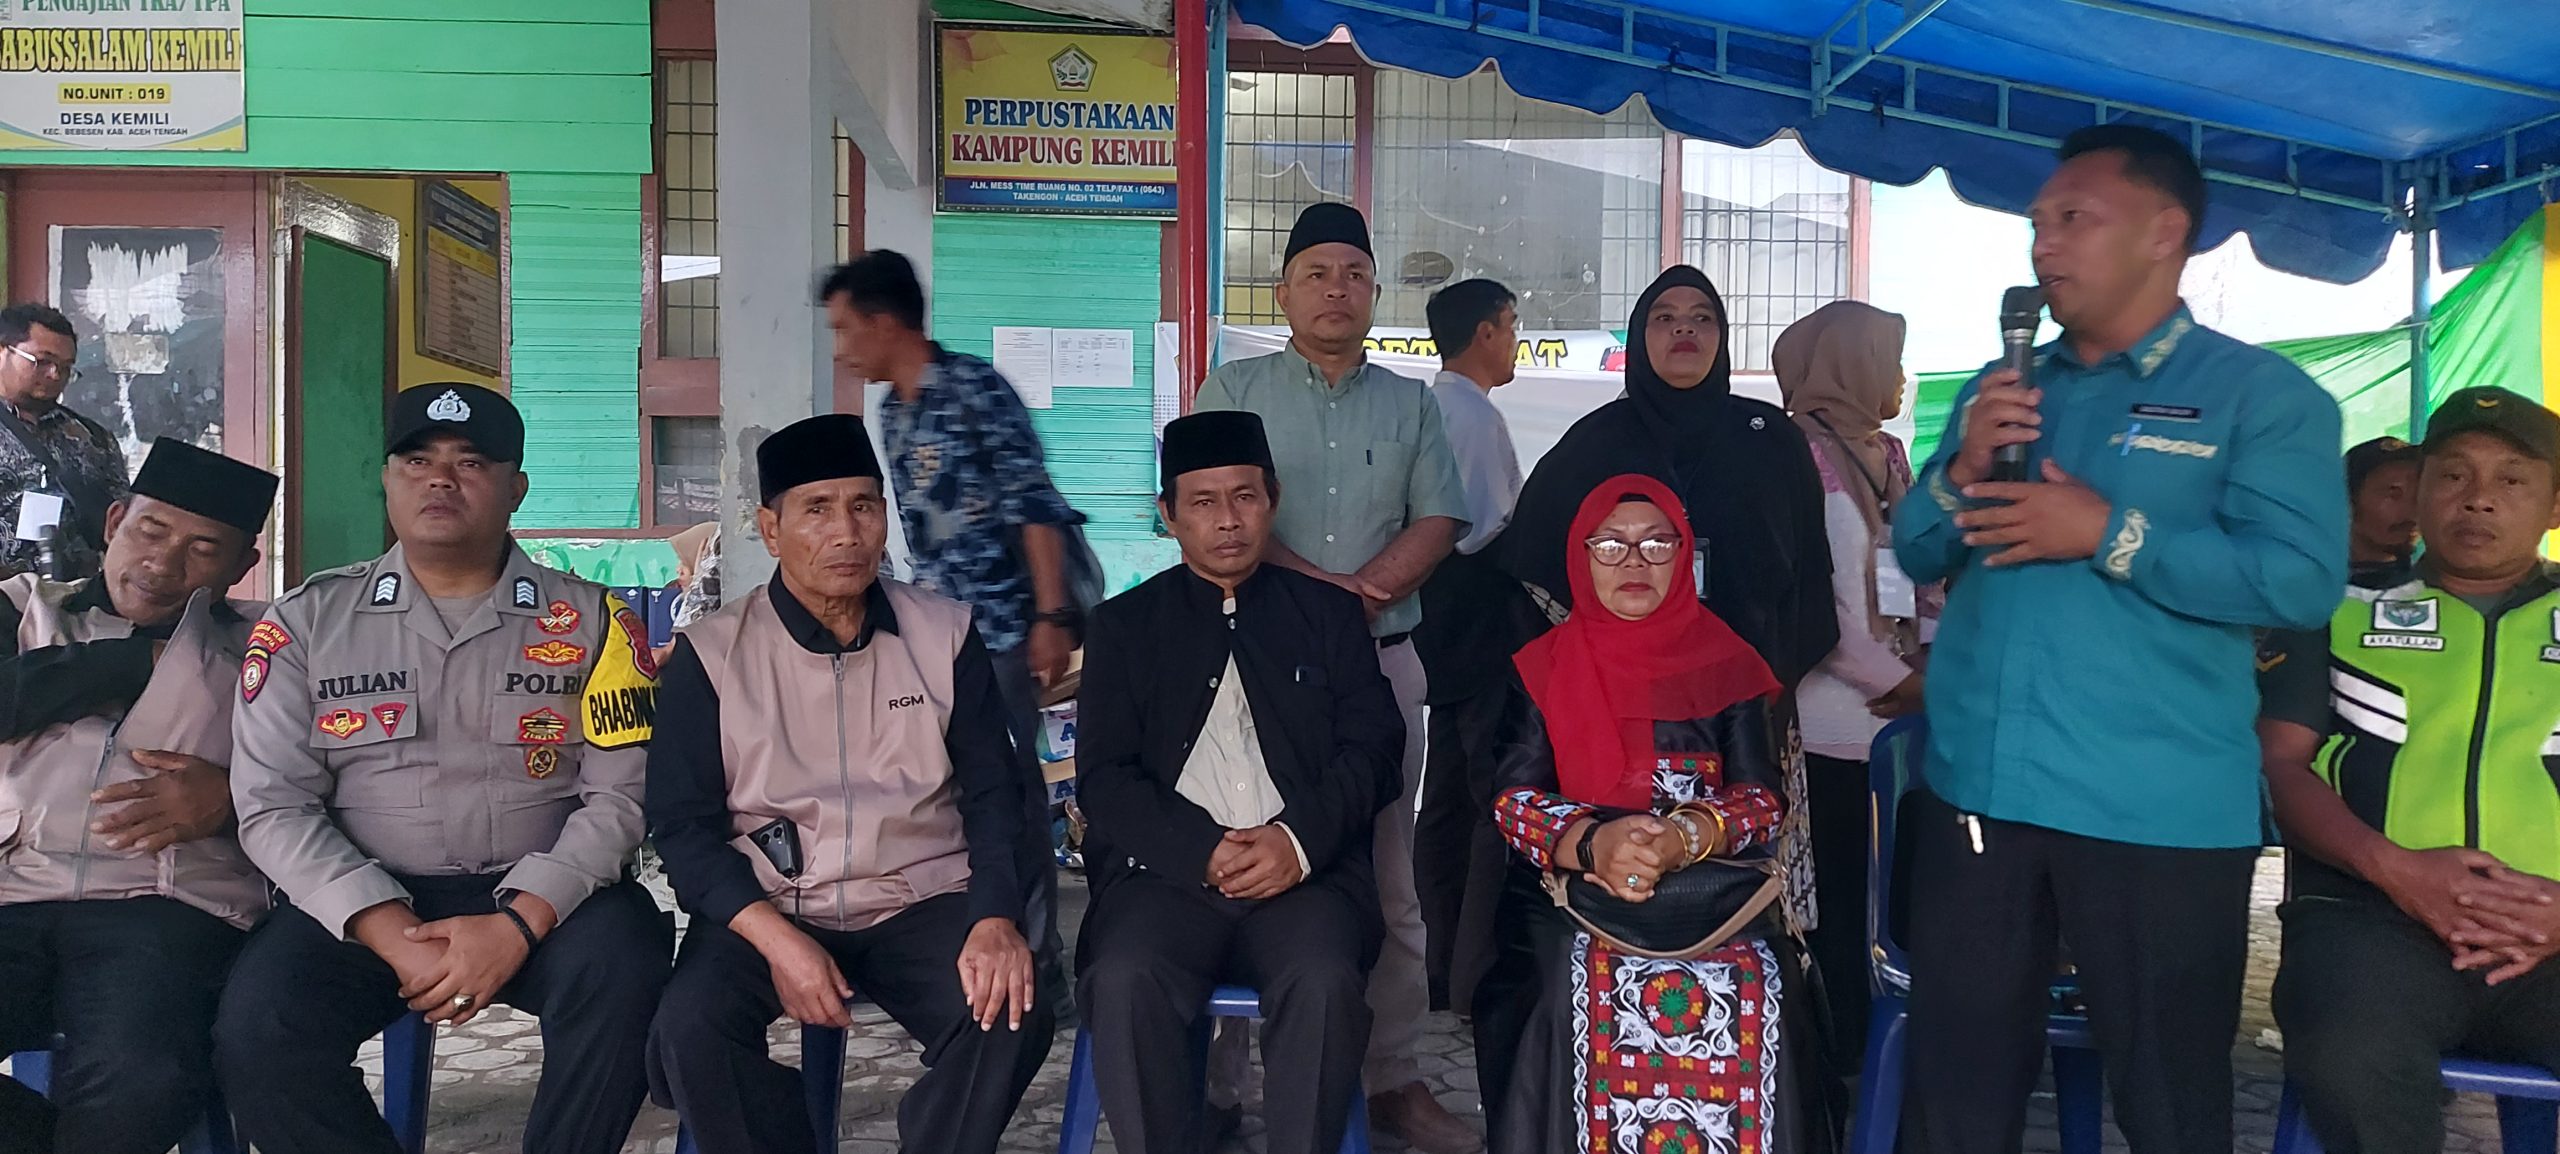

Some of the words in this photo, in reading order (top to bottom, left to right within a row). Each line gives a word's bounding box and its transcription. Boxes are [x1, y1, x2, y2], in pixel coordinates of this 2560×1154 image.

[22, 0, 130, 15] PENGAJIAN
[0, 28, 148, 72] ABUSSALAM
[149, 28, 241, 72] KEMILI
[63, 88, 124, 100] NO.UNIT
[138, 88, 165, 100] 019
[60, 112, 105, 125] DESA
[111, 112, 169, 125] KEMILI
[965, 98, 1175, 131] PERPUSTAKAAN
[42, 128, 62, 136] KEC.
[65, 128, 104, 136] BEBESEN
[128, 128, 151, 136] ACEH
[154, 128, 188, 136] TENGAH
[952, 134, 1083, 165] KAMPUNG
[970, 181, 988, 190] JLN.
[990, 181, 1013, 190] MESS
[1015, 182, 1035, 191] TIME
[1037, 183, 1066, 192] RUANG
[1068, 184, 1082, 193] NO.
[1084, 184, 1094, 192] 02
[1013, 192, 1058, 201] TAKENGON
[1065, 193, 1087, 202] ACEH
[1089, 194, 1123, 203] TENGAH
[2369, 636, 2438, 647] AYATULLAH
[317, 671, 407, 700] JULIAN
[505, 673, 582, 695] POLRI
[889, 694, 924, 711] RGM
